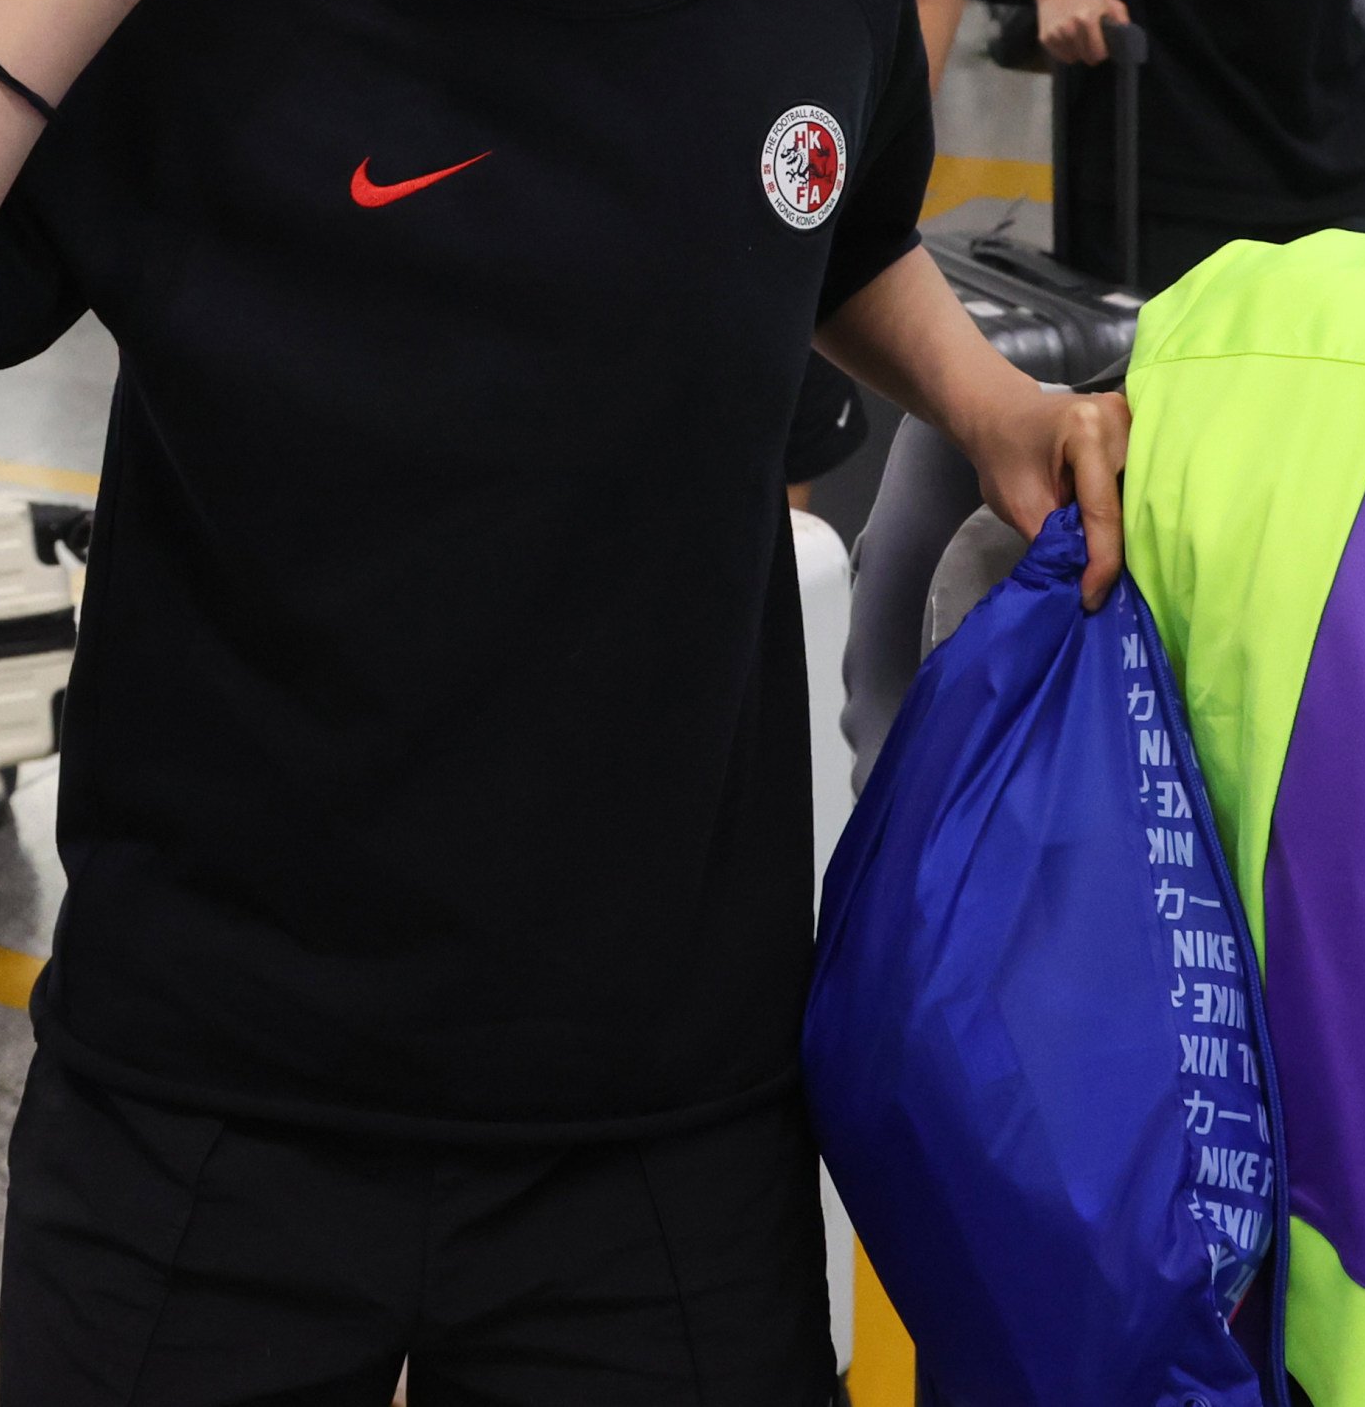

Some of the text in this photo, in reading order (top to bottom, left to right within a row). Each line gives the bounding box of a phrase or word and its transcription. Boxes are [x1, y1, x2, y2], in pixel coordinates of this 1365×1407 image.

[765, 109, 844, 155] THE FOOTBALL ASSOCIATION
[774, 197, 795, 222] HONG
[818, 197, 836, 221] CHINA
[1173, 929, 1237, 973] NIKE
[1196, 1146, 1260, 1194] NIKE
